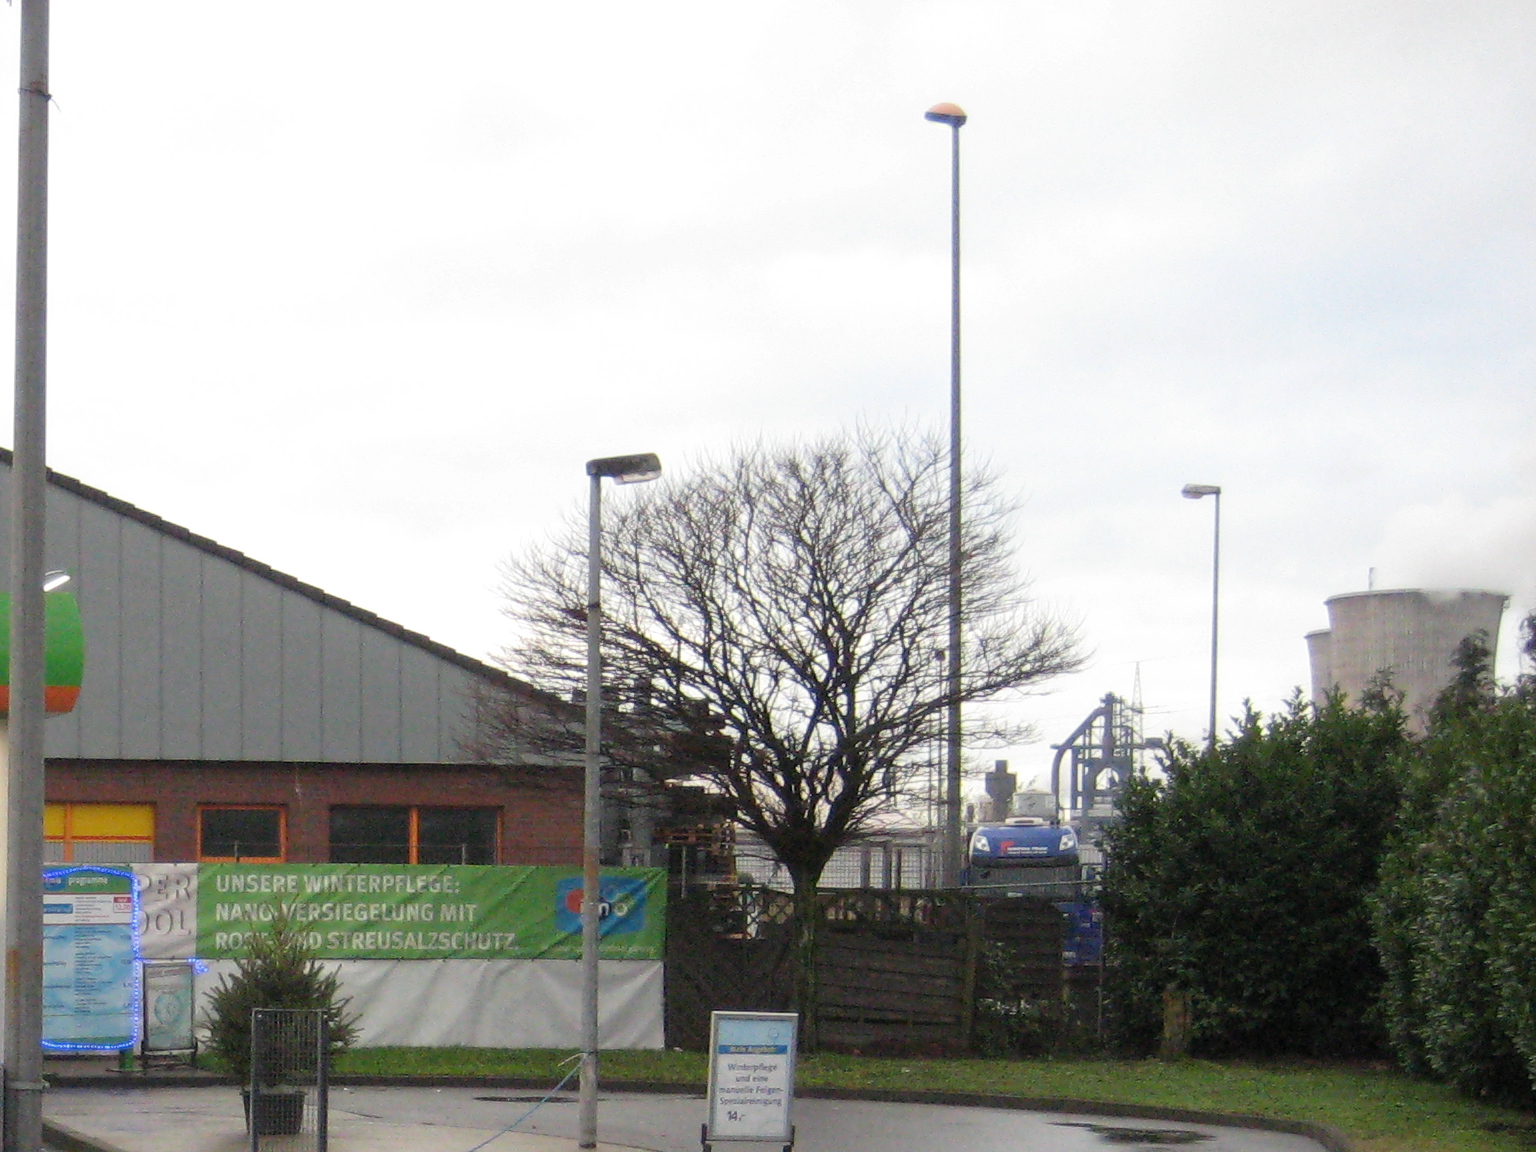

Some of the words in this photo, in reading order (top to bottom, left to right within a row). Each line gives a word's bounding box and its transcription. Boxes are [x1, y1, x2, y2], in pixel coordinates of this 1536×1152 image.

[216, 874, 299, 893] UNSERE
[303, 875, 460, 894] WINTERPFLEGE:
[439, 904, 478, 922] MIT
[727, 1063, 778, 1073] Winterpflege
